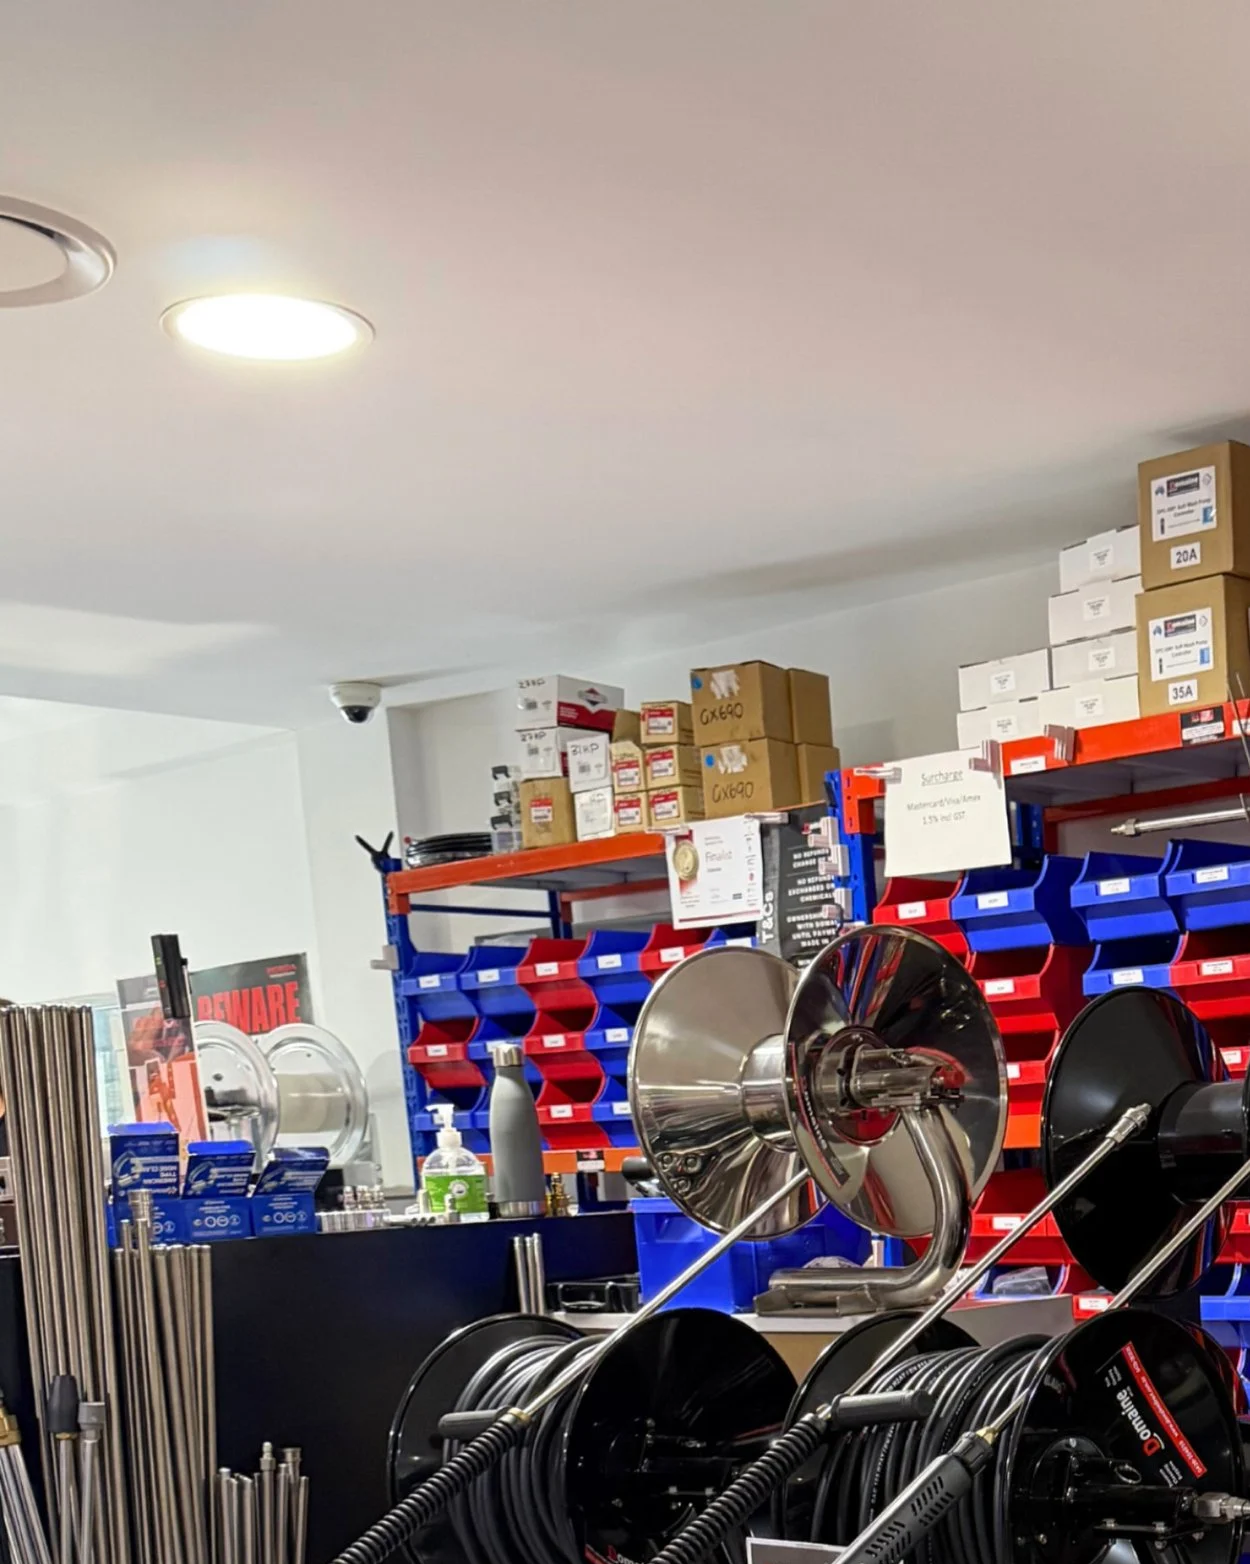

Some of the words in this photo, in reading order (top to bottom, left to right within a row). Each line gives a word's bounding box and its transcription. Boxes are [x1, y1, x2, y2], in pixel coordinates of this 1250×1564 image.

[1175, 548, 1198, 564] 20A
[1172, 683, 1193, 700] 35A
[700, 702, 744, 725] GX690
[712, 781, 754, 803] GX690
[800, 893, 835, 904] CHEMICAL
[761, 890, 774, 944] T&Cs
[787, 913, 824, 923] OWNERSHI
[197, 981, 301, 1035] BEWARE
[1116, 1388, 1165, 1457] Domaine
